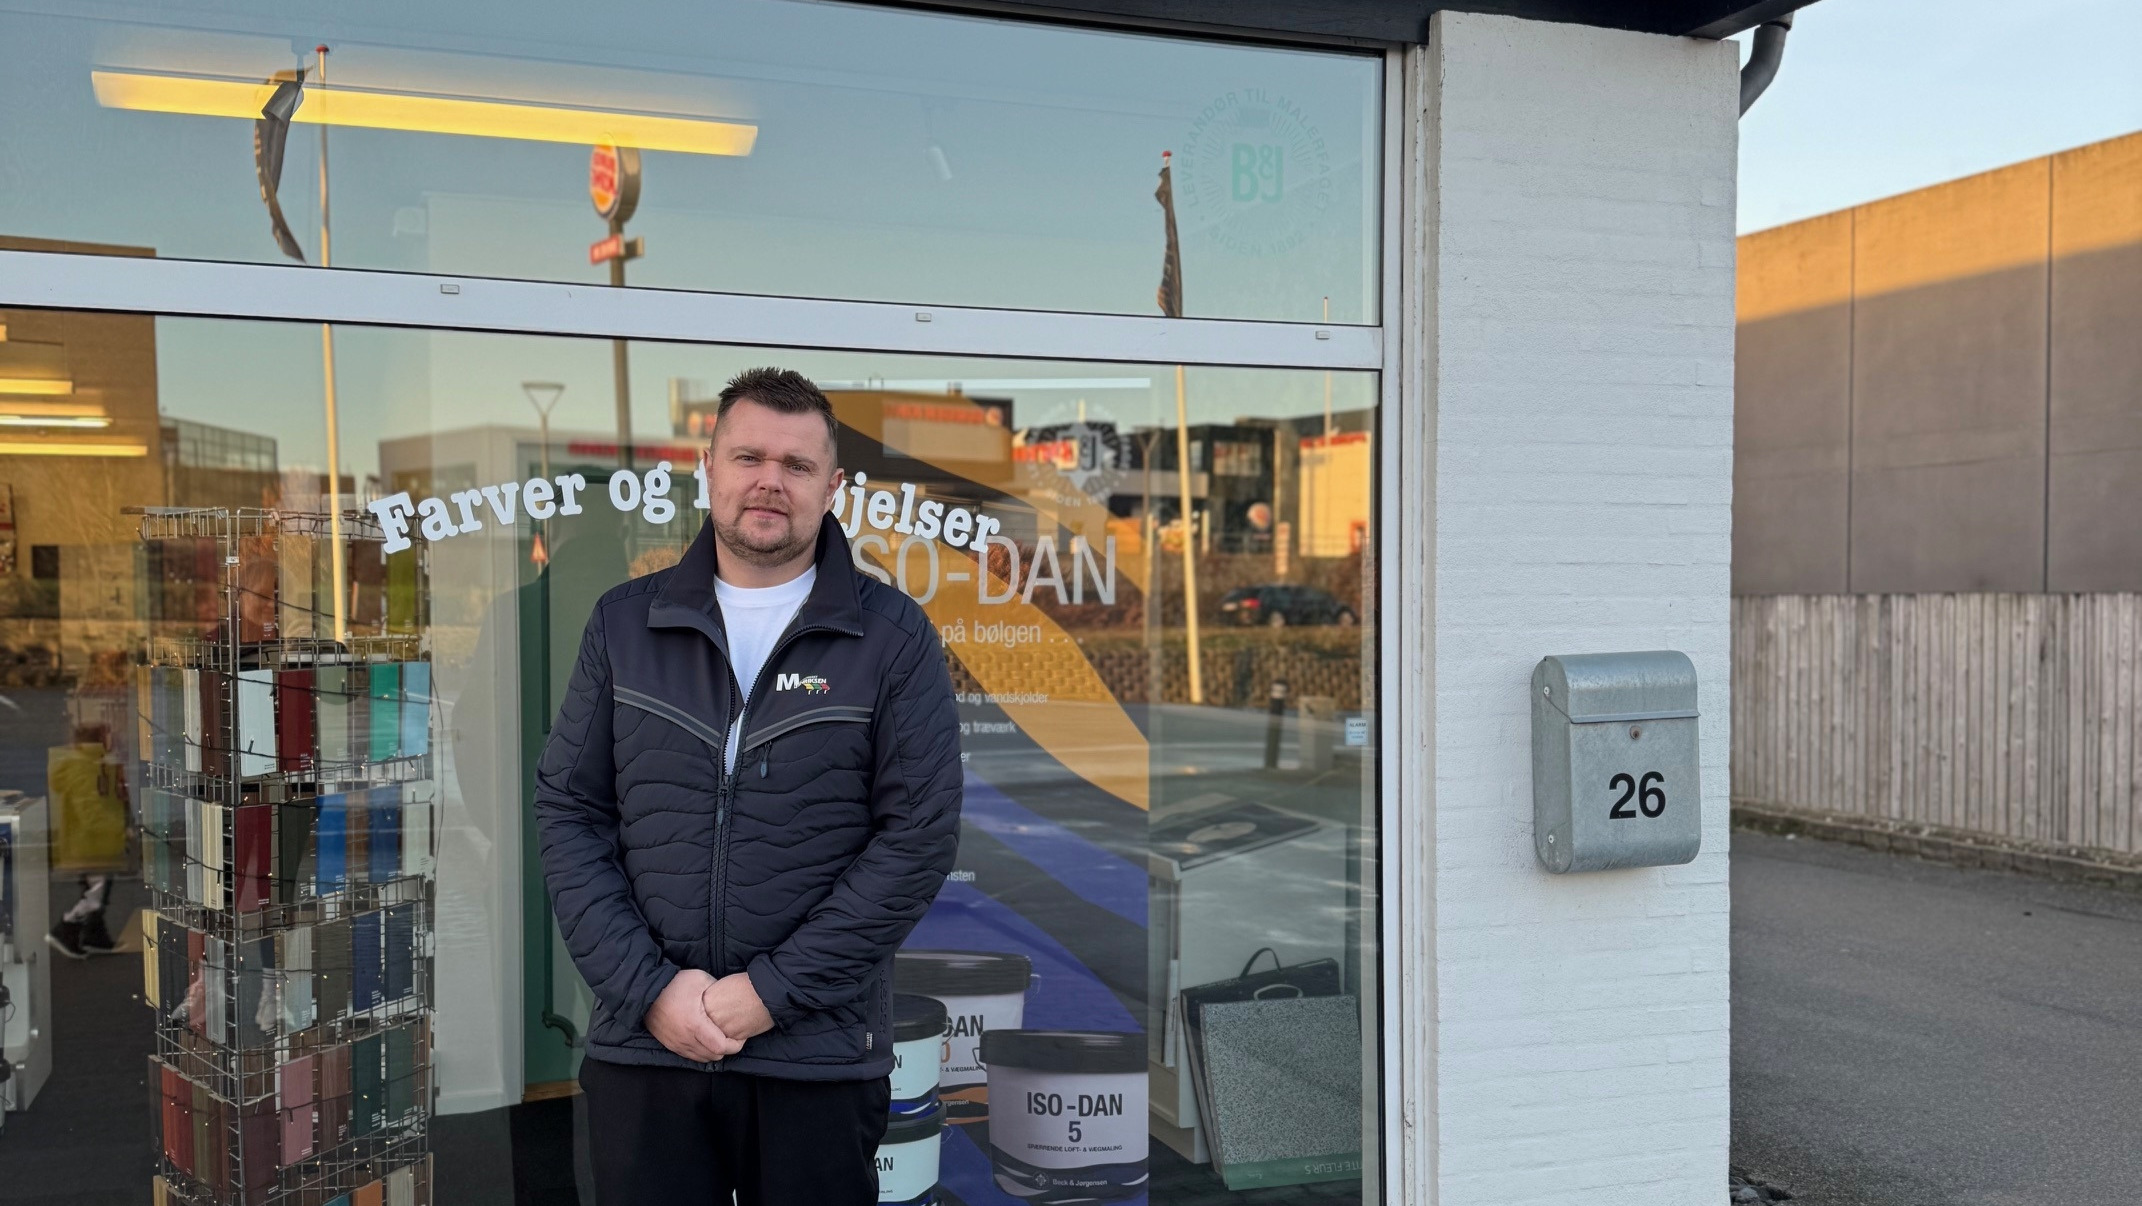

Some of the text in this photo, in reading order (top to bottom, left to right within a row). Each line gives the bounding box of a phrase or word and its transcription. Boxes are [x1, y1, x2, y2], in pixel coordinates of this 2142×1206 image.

[1181, 91, 1239, 209] LEVERANDØR
[1245, 87, 1271, 104] TIL
[1232, 142, 1284, 203] B&J
[368, 473, 587, 554] Farver
[608, 460, 676, 524] og
[852, 535, 1116, 606] SO-DAN
[941, 618, 967, 648] på
[974, 620, 1041, 648] bølgen
[967, 692, 982, 706] og
[984, 691, 1049, 706] vandskjolder
[1608, 771, 1666, 820] 26
[1067, 1120, 1082, 1143] 5
